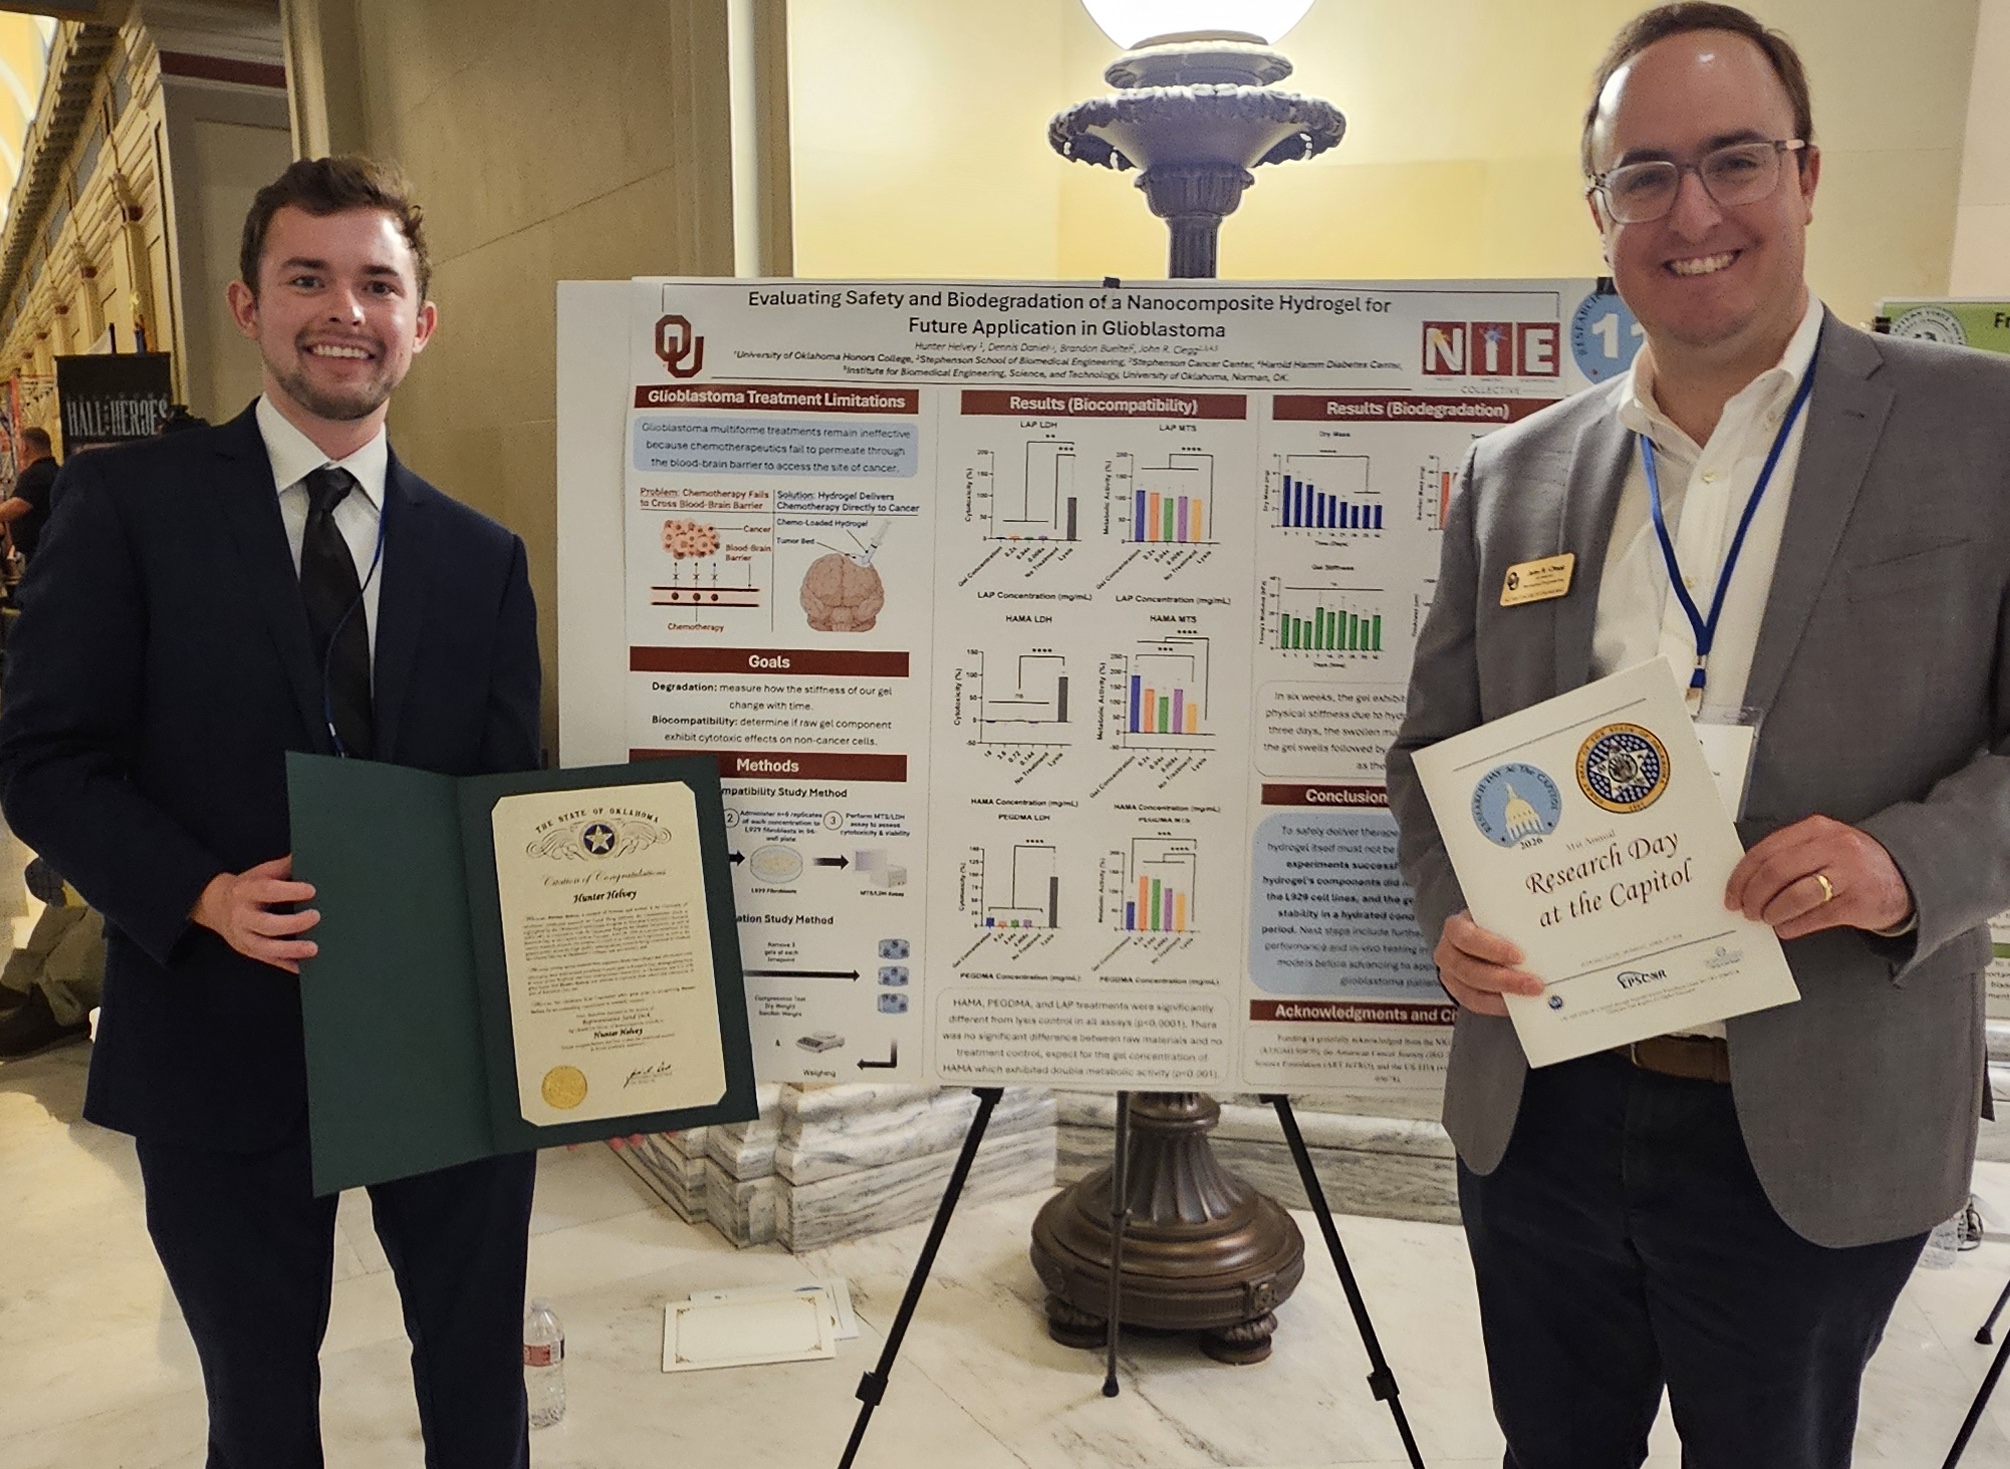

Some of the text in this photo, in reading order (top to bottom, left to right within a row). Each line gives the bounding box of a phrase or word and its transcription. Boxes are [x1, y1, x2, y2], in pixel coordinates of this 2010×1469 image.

[748, 290, 1392, 315] Evaluating Safety and Biodegradation of a Nanocomposite Hydrogel for
[908, 317, 1225, 338] Future Application in Glioblastoma
[655, 314, 704, 378] OU
[794, 351, 841, 360] Oklahoma
[842, 352, 875, 362] Honors
[974, 355, 1006, 364] School
[1018, 356, 1070, 366] Biomedical
[885, 367, 899, 376] for
[647, 389, 906, 408] Glioblastoma Treatment Limitations
[1009, 396, 1198, 415] Results (Biocompatibility)
[1326, 401, 1510, 419] Results (Biodegradation)
[66, 400, 105, 436] HALL
[1019, 420, 1058, 429] LAP LDH
[641, 422, 910, 438] Glioblastoma multiforme treatments remain ineffective
[645, 440, 905, 457] because chemotherapeutics fail to permeate through
[650, 458, 899, 472] the blood-brain barrier to access the site of cancer.
[639, 488, 769, 499] Problem: Chemotherapy Fails
[776, 490, 894, 502] Solution: Hydrogel Delivers
[639, 500, 763, 510] to Cross Blood-Brain Barrier
[776, 502, 920, 514] Chemotherapy Directly to Cancer
[742, 524, 771, 533] Cancer
[977, 591, 995, 599] LAP
[996, 591, 1056, 599] Concentration
[1034, 615, 1052, 623] LDH
[667, 622, 724, 632] Chemotherapy
[748, 654, 790, 668] Goals
[651, 681, 892, 697] Degradation: measure how the stiffness of our gel
[729, 701, 813, 711] change with time.
[651, 715, 738, 727] Biocompatibility:
[739, 718, 789, 726] determine
[790, 718, 798, 726] if
[819, 719, 834, 729] gel
[835, 720, 892, 729] component
[664, 733, 878, 746] exhibit cytotoxic effects on non-cancer cells.
[736, 758, 799, 772] Methods
[722, 787, 847, 798] mpatibility Study Method
[536, 820, 554, 834] THE
[558, 810, 587, 822] STATE
[610, 808, 659, 824] OKLAHOMA
[726, 814, 734, 822] 2
[830, 816, 836, 825] 3
[1520, 838, 1543, 850] 2026
[1525, 833, 1678, 894] Research Day
[573, 891, 604, 904] Hunter
[1540, 857, 1692, 927] at the Capitol
[764, 914, 794, 925] Study
[795, 914, 834, 925] Method
[1275, 1004, 1438, 1022] Acknowledgments and
